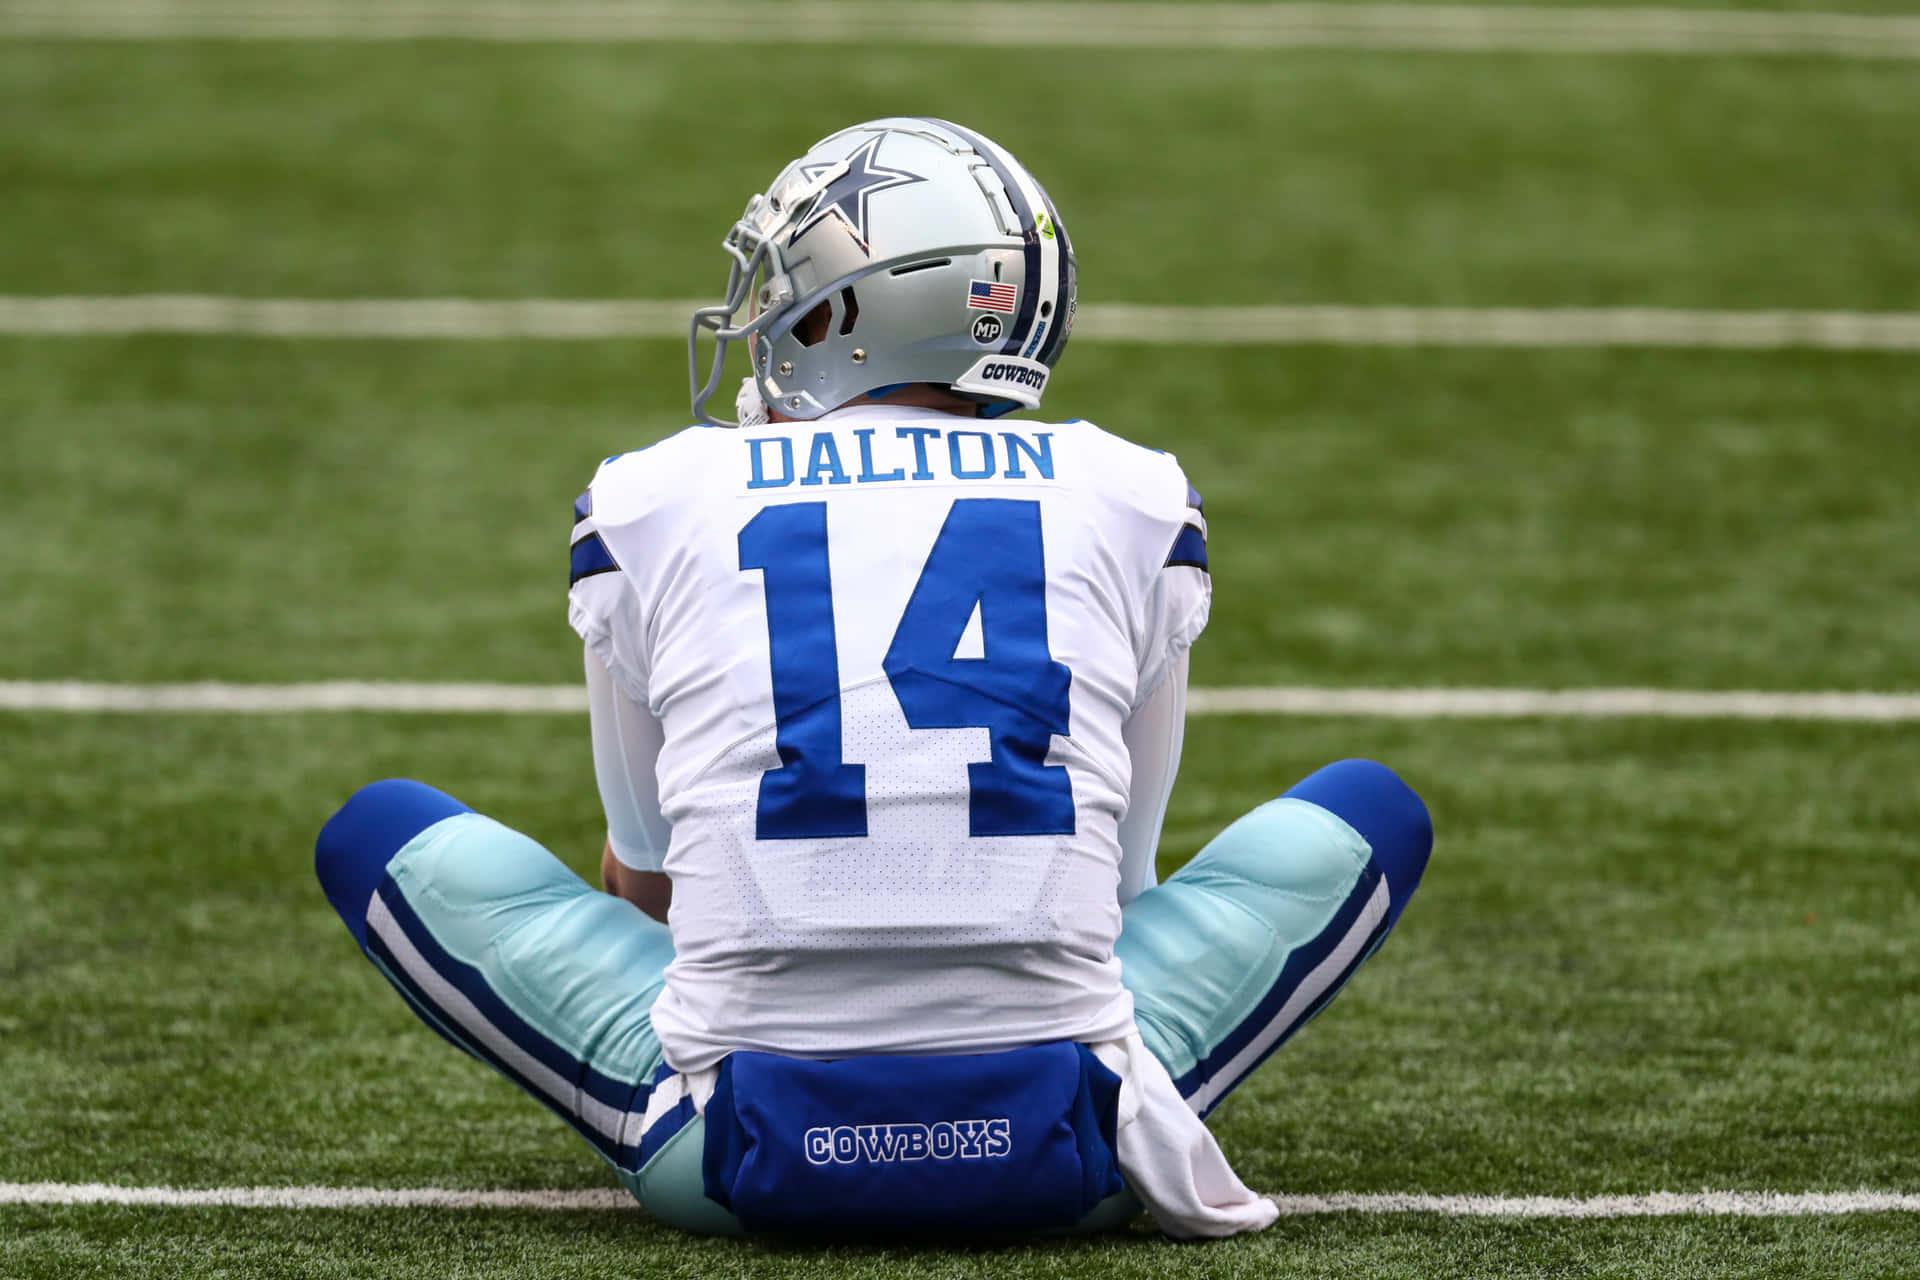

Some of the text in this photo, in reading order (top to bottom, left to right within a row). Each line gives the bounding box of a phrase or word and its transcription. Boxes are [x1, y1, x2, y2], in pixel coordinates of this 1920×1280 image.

[975, 324, 999, 338] MP
[982, 363, 1046, 390] COWBOYS
[744, 427, 1055, 489] DALTON
[737, 498, 1076, 840] 14
[804, 1118, 1012, 1165] COWBOYS
